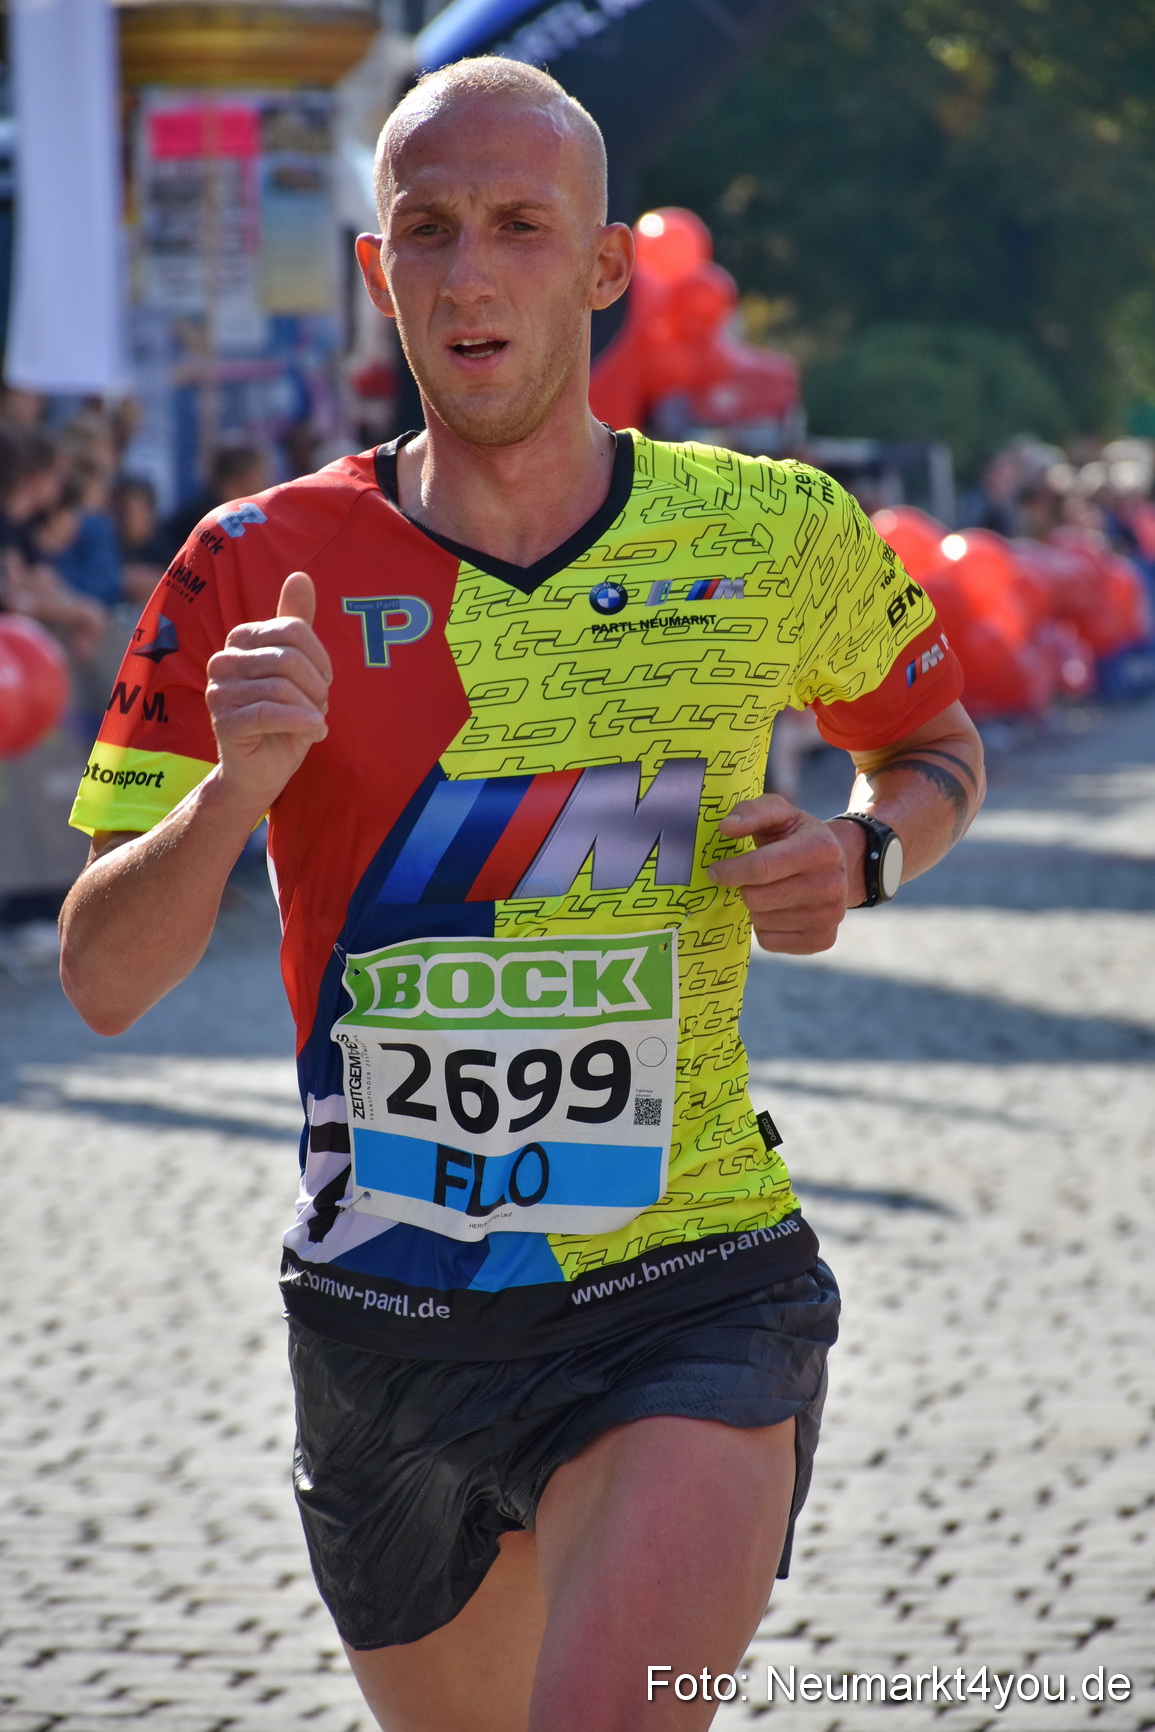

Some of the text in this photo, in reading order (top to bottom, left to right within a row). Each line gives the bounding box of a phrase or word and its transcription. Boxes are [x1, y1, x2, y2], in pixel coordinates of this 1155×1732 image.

[591, 614, 716, 634] PARTL NEUMARKT
[366, 953, 645, 1013] BOCK
[378, 1039, 631, 1135] 2699
[433, 1142, 549, 1217] FLO
[570, 1218, 801, 1306] www.bmw-partl.de
